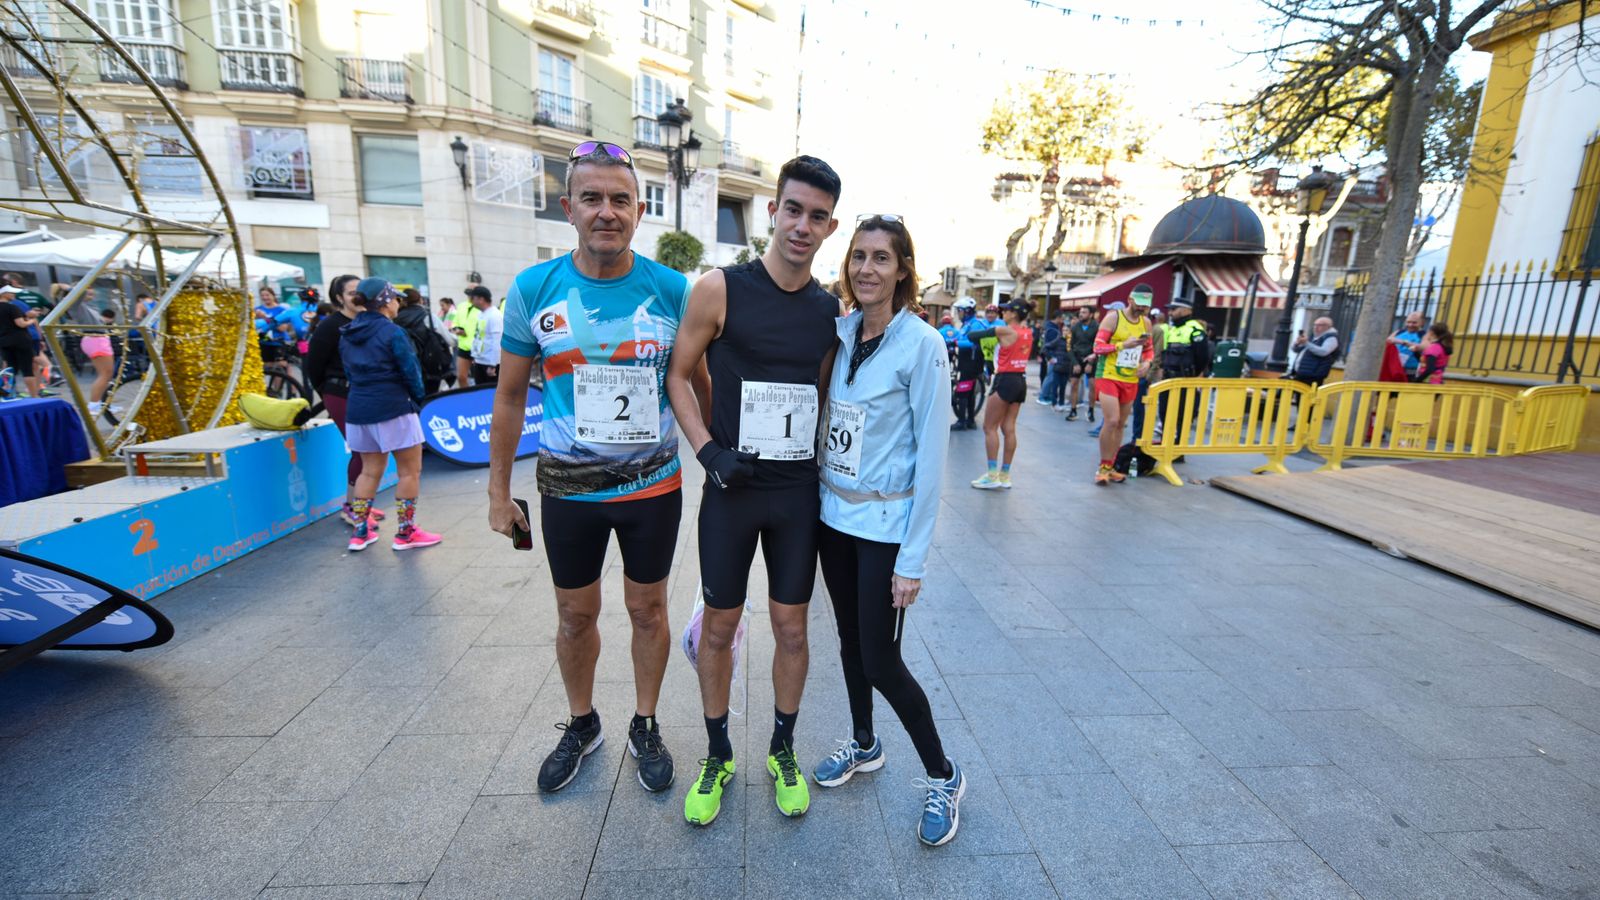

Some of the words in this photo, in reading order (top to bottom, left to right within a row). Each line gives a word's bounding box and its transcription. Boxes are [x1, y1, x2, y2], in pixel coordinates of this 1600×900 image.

[614, 395, 630, 421] 2
[782, 413, 792, 438] 1
[284, 437, 297, 464] 1
[825, 427, 852, 455] 59
[129, 518, 159, 556] 2
[191, 553, 211, 571] de
[213, 529, 270, 562] Deportes
